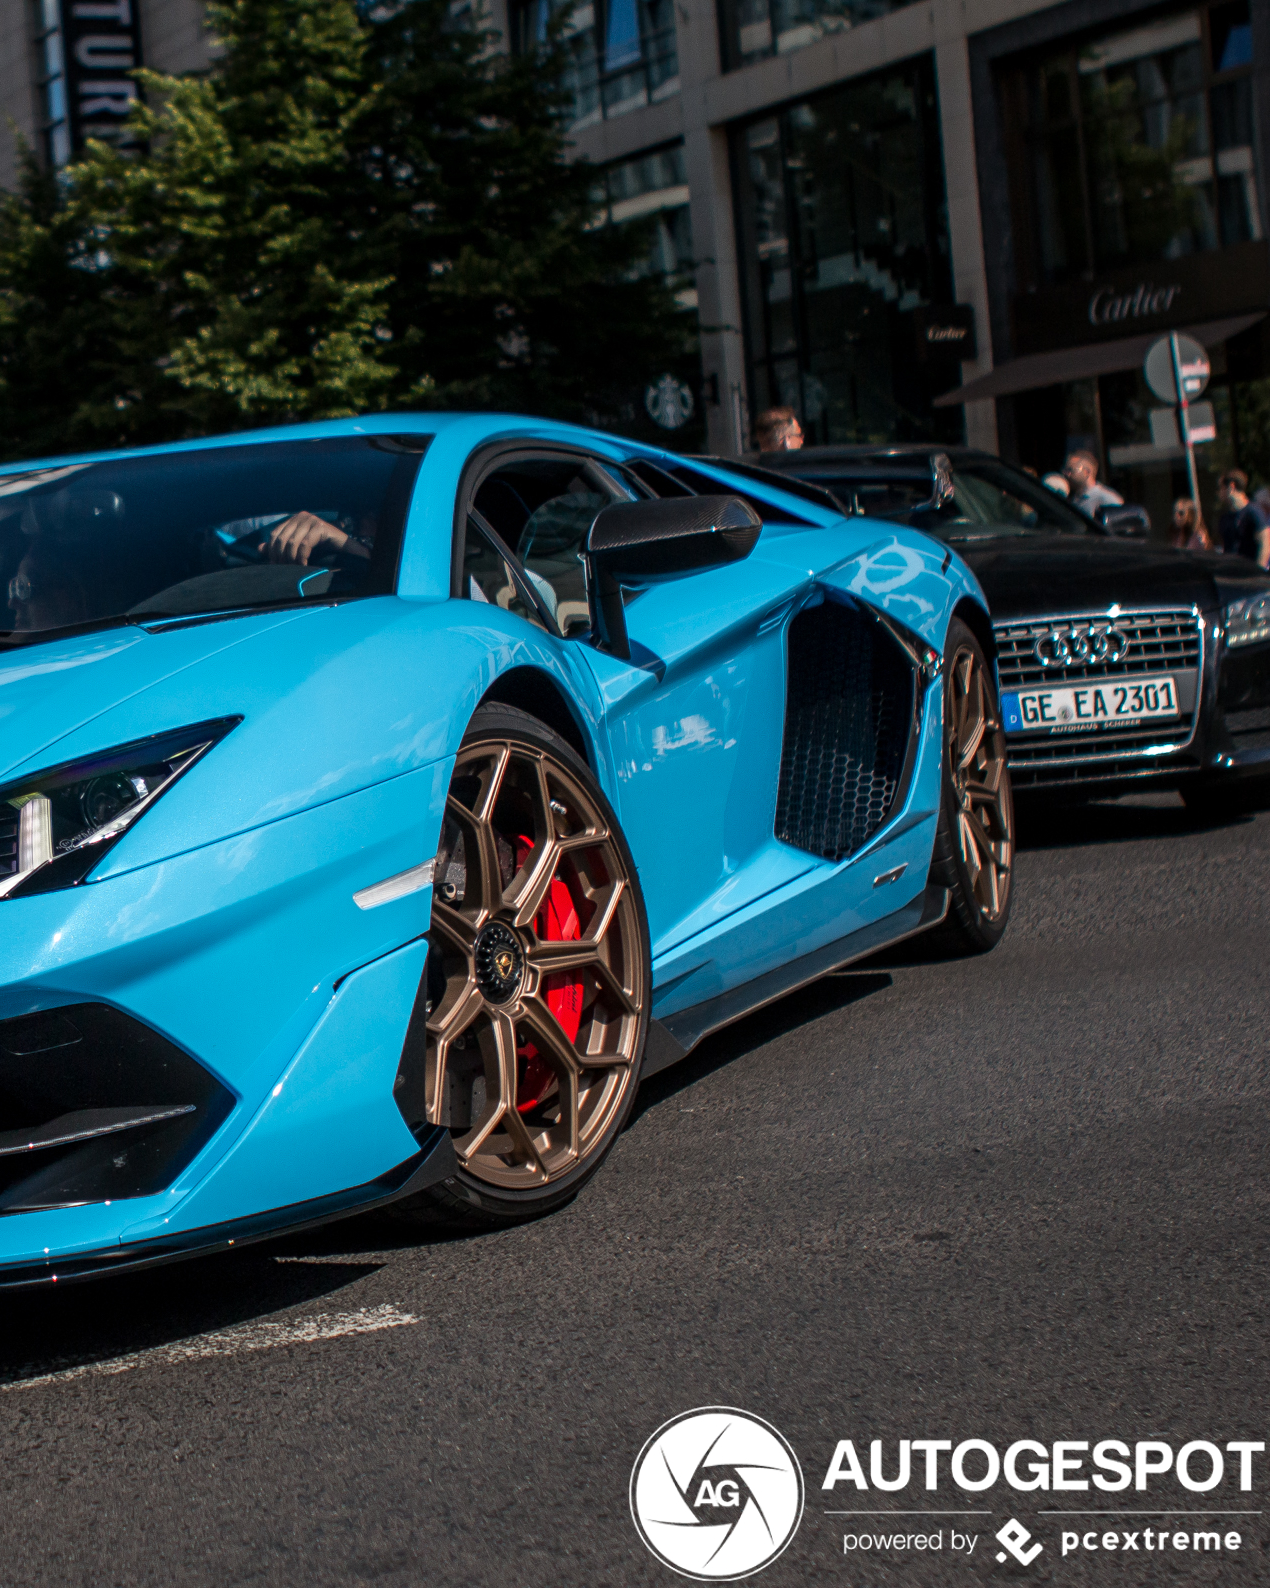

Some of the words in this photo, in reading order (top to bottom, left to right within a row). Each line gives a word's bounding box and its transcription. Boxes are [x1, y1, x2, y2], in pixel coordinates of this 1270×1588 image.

[1088, 282, 1180, 325] Cartier
[1010, 714, 1018, 724] D
[1021, 694, 1056, 723] GE
[1074, 690, 1108, 718] EA
[1114, 682, 1175, 714] 2301
[1050, 722, 1098, 734] AUTOHAUS
